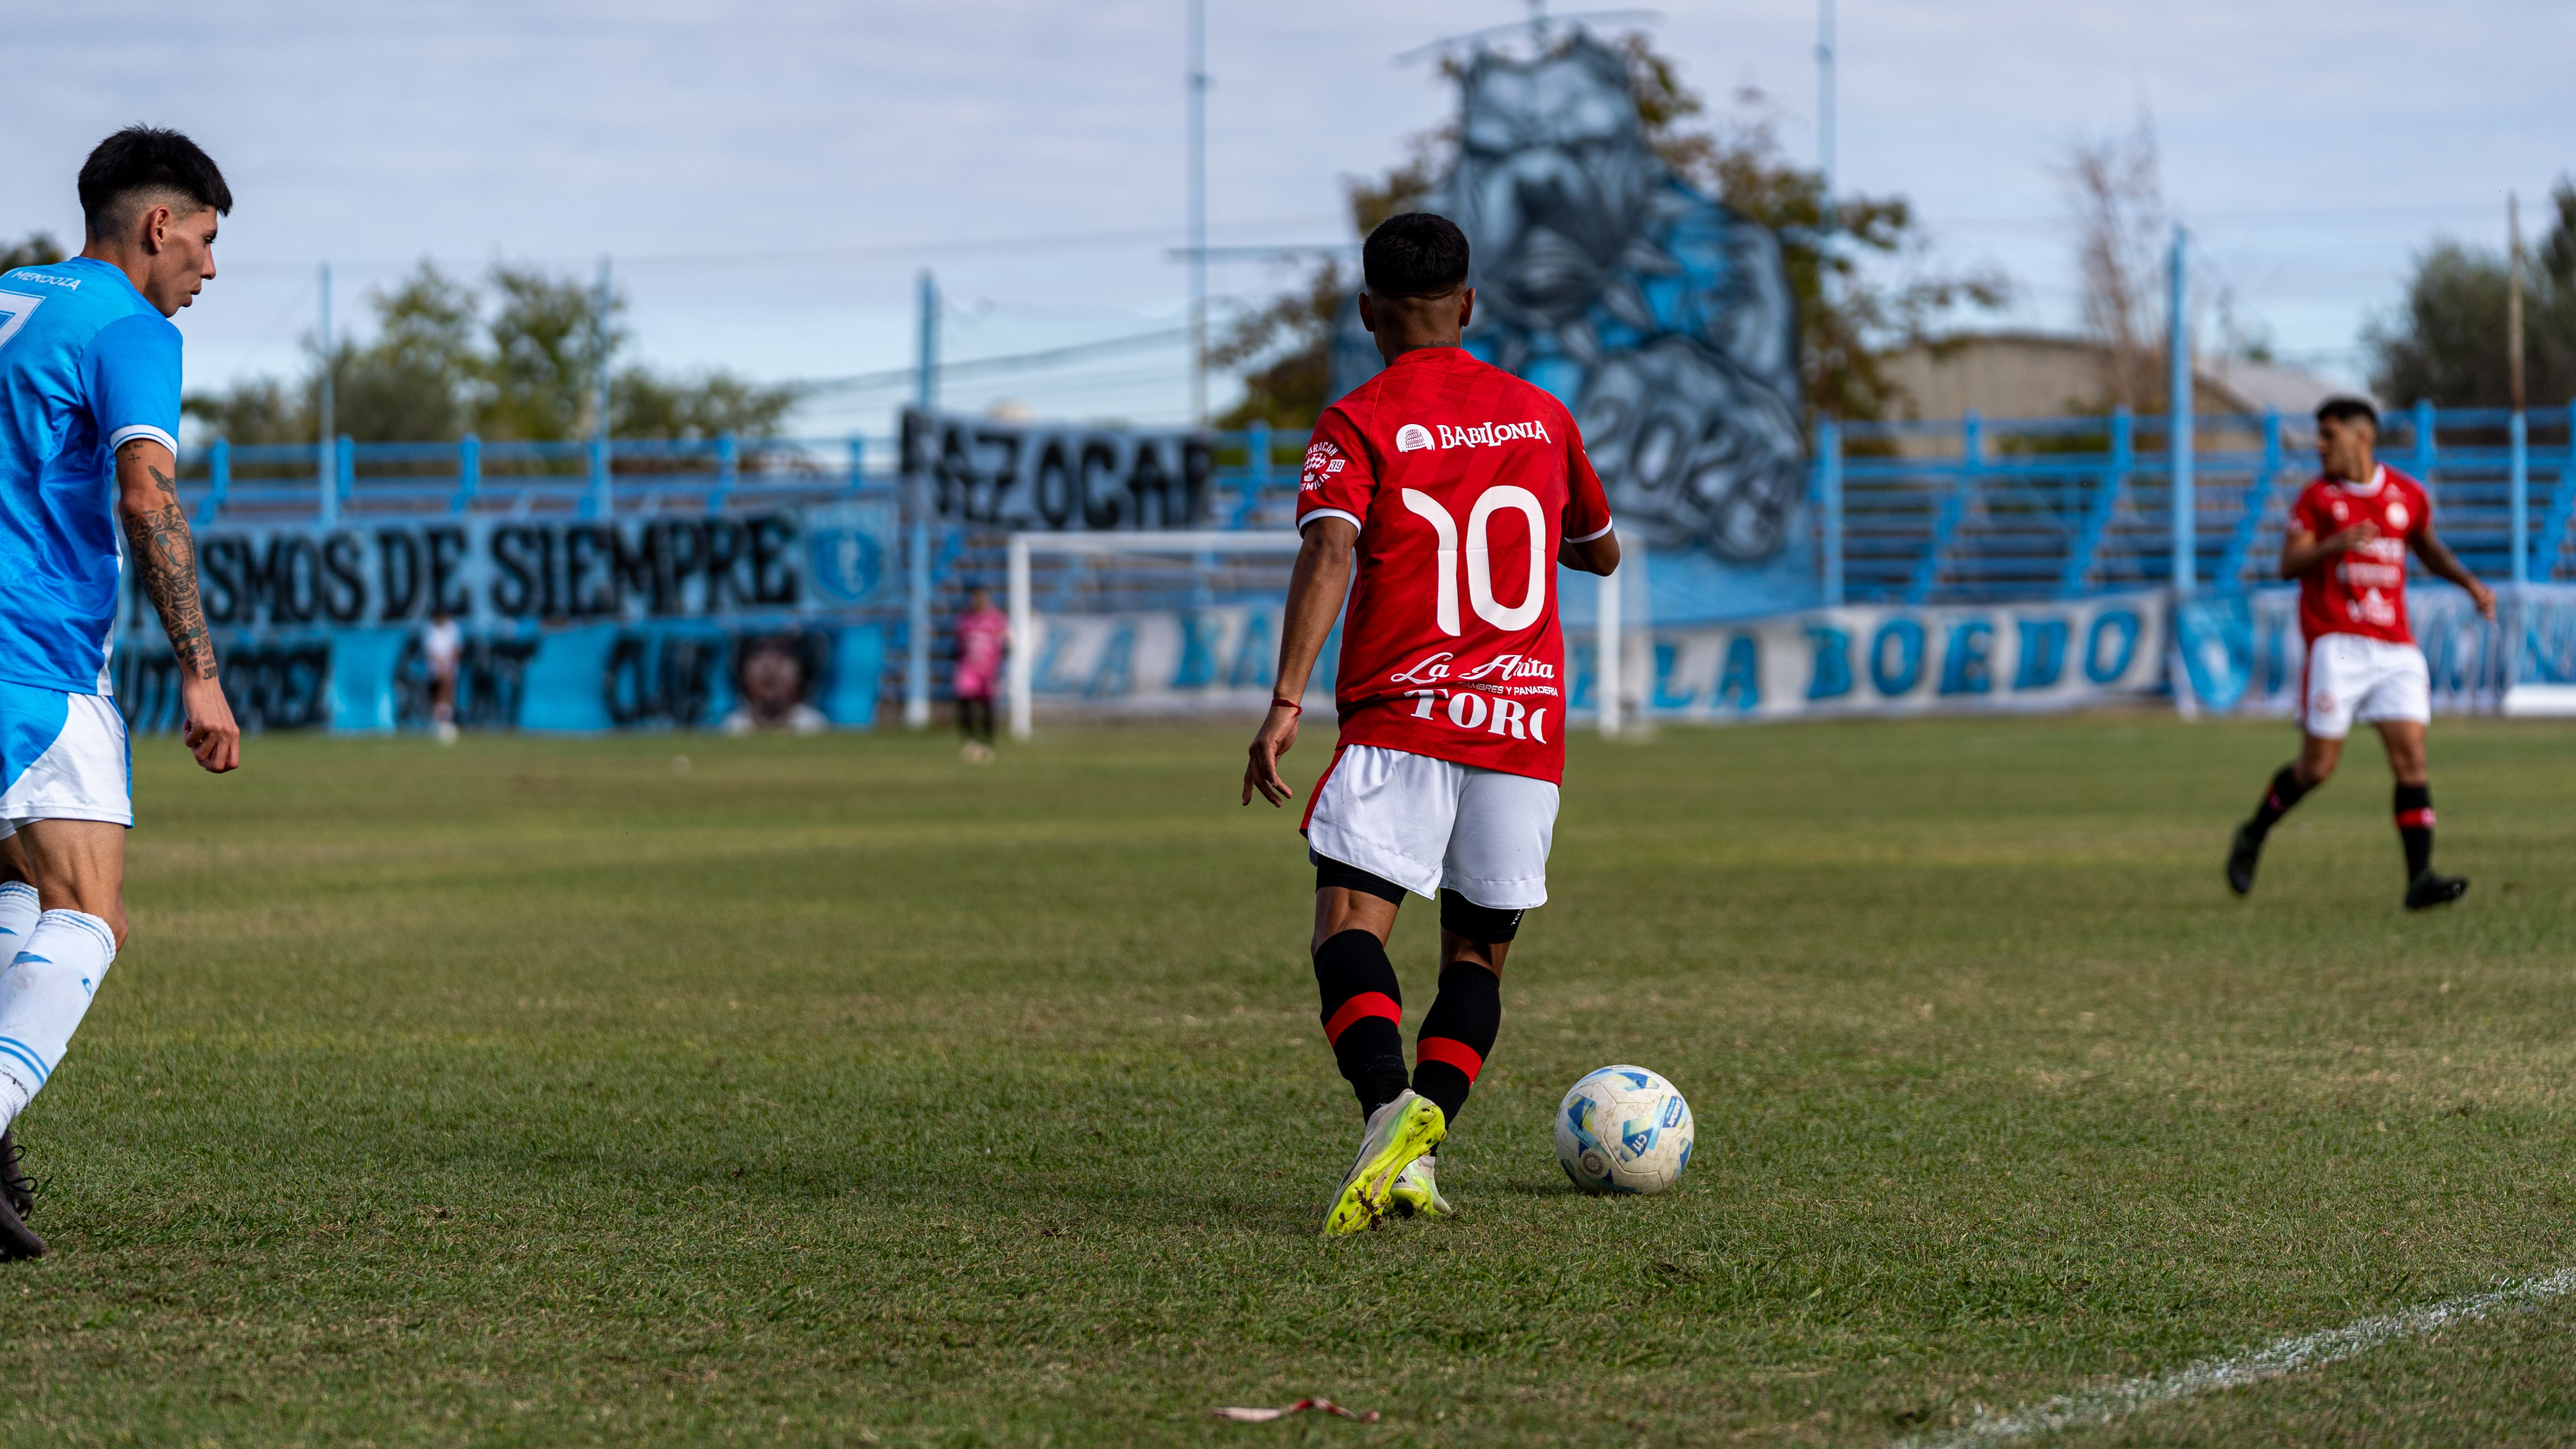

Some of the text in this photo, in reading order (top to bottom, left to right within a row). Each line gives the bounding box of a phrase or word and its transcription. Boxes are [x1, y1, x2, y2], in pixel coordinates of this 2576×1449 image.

[11, 271, 82, 291] MENDOZA
[1330, 461, 1343, 470] 39
[1299, 473, 1331, 494] FAMILIA
[378, 527, 469, 621] DE
[489, 515, 797, 618] SIEMPRE
[1402, 485, 1546, 636] 10
[1391, 652, 1453, 684] La
[1651, 633, 1759, 709] LA
[1807, 608, 2141, 700] BOEDO
[1456, 682, 1504, 694] FIAMBRES
[1505, 686, 1513, 695] Y
[1632, 1134, 1647, 1152] C11
